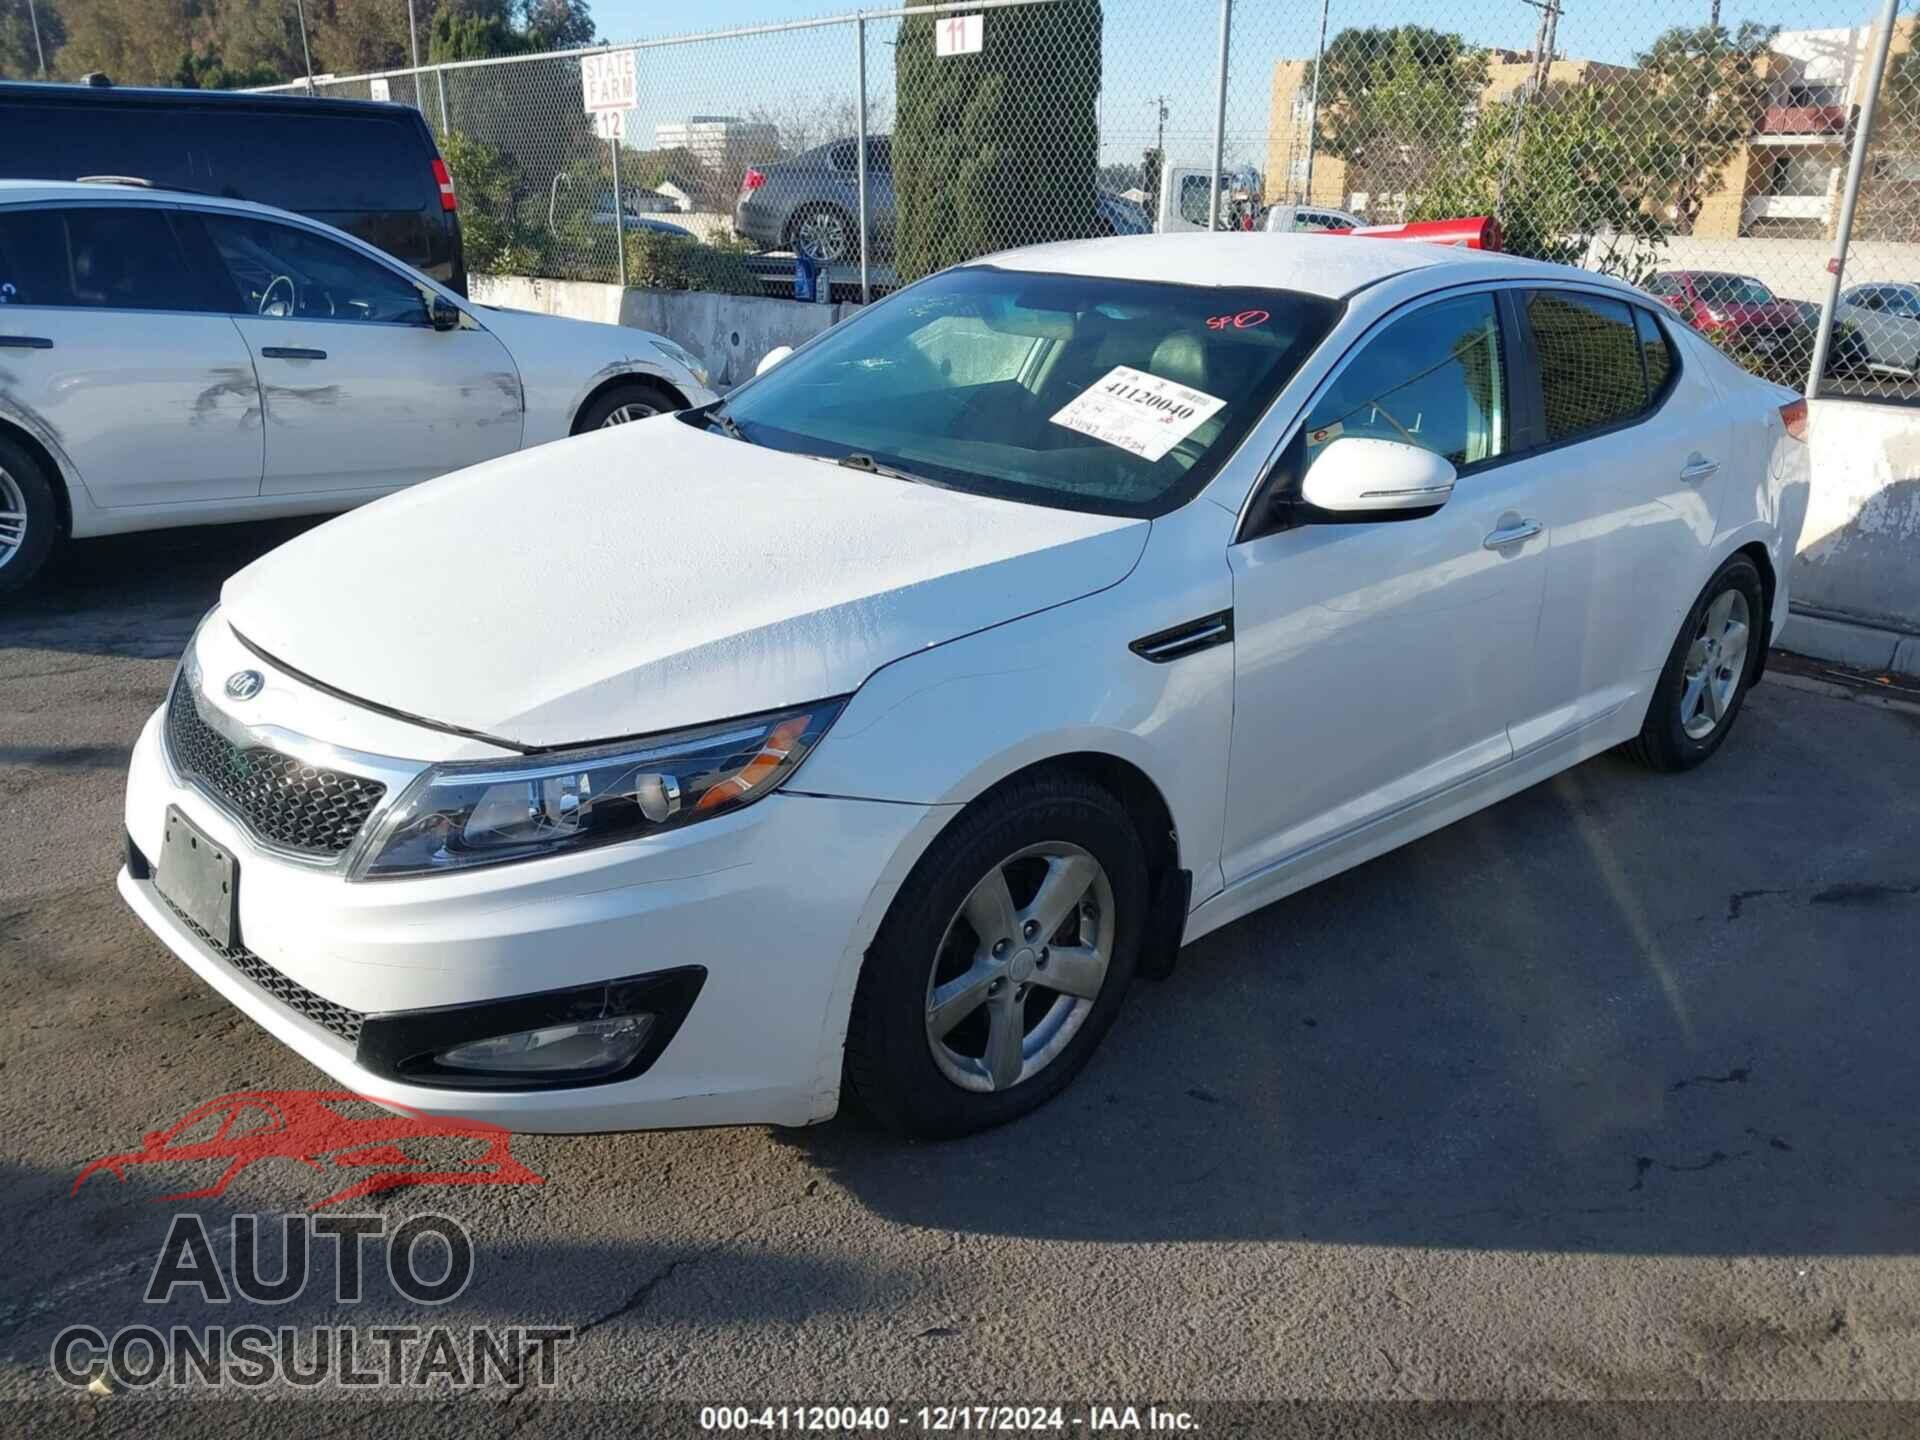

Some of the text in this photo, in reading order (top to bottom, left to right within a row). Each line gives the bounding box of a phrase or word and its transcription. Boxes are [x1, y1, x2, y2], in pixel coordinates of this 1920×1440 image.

[946, 18, 966, 52] 11
[586, 51, 633, 79] STATE
[590, 76, 633, 101] FARM
[602, 112, 621, 136] 12
[1105, 382, 1195, 420] 41120040
